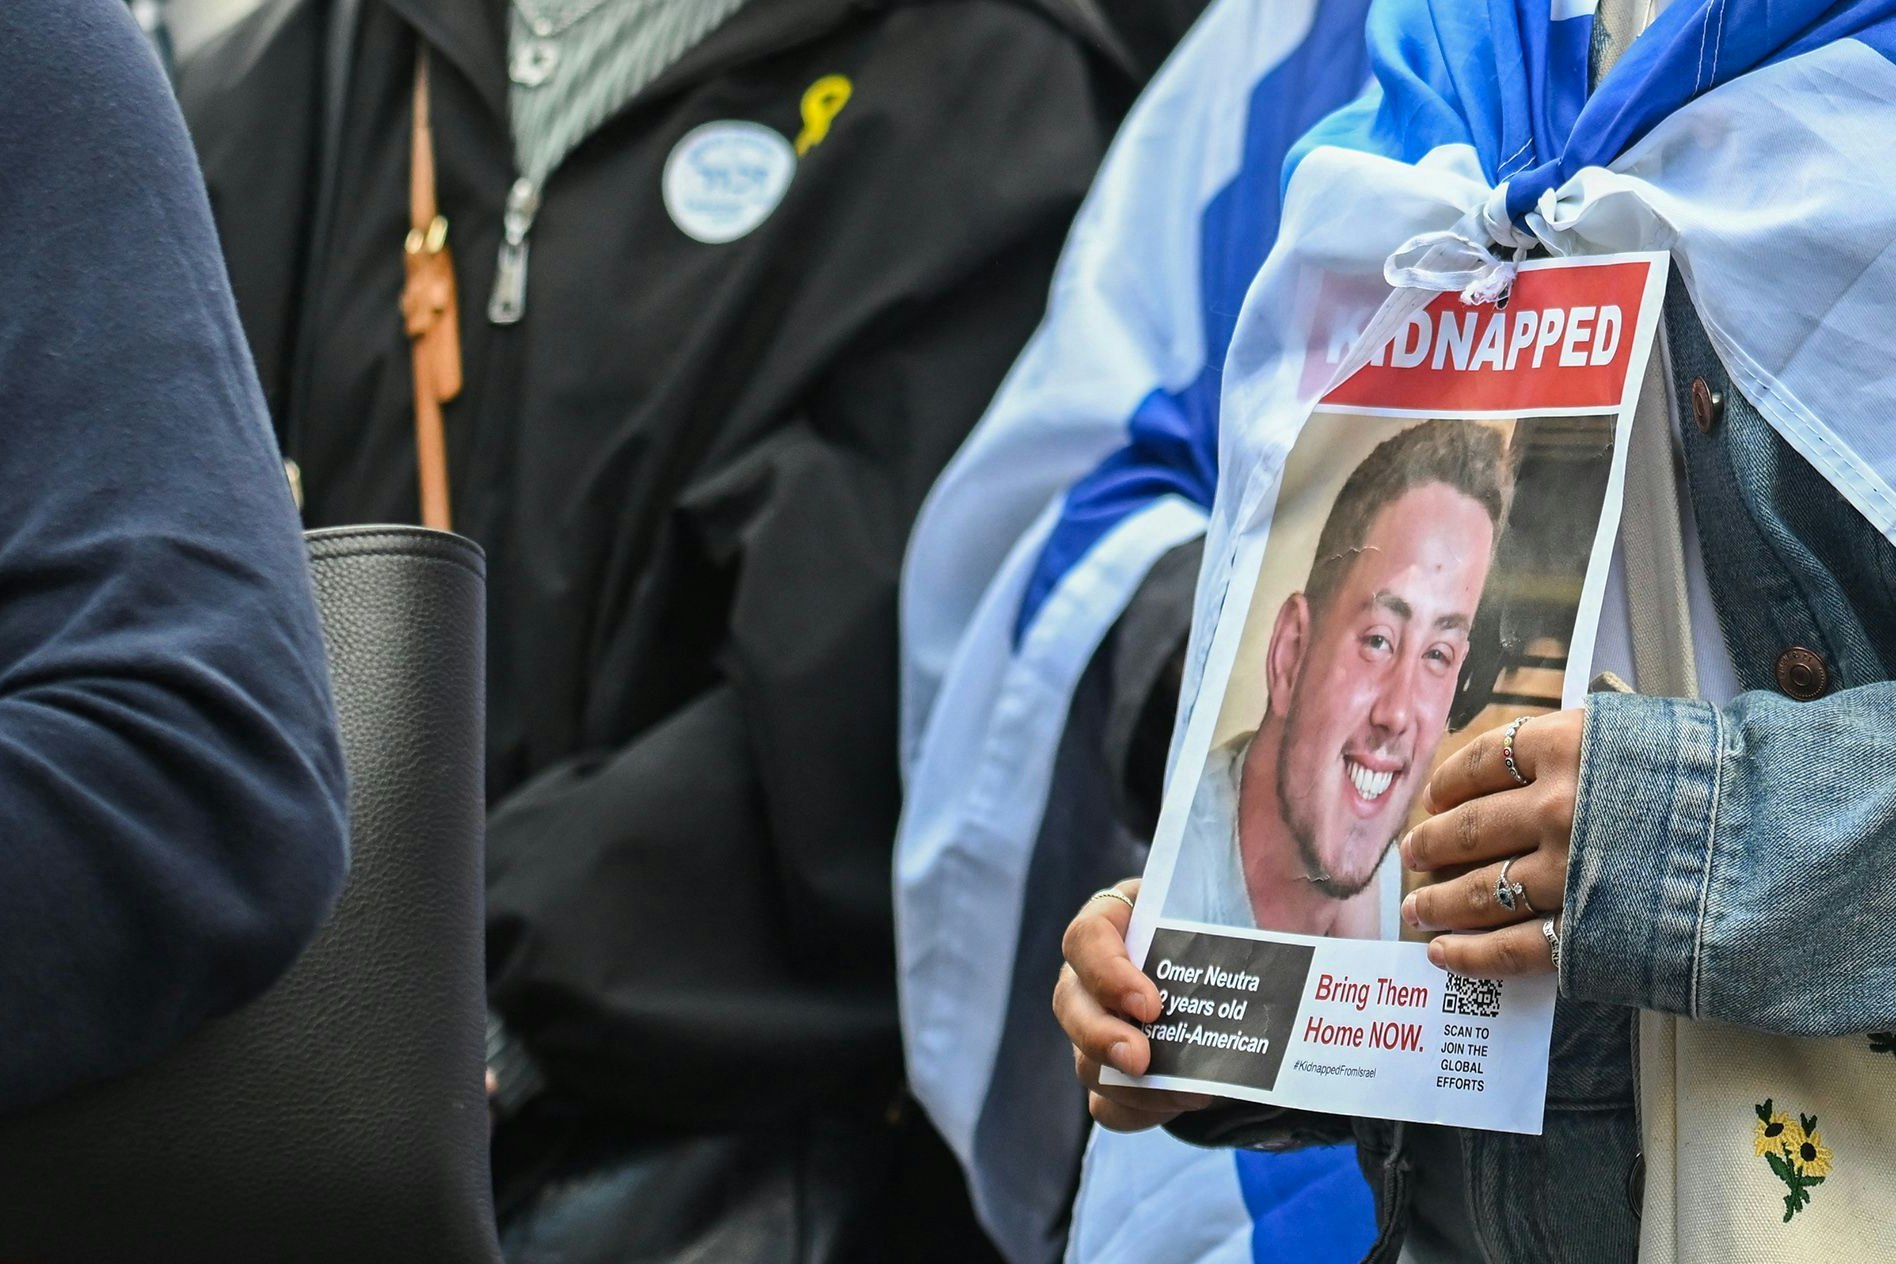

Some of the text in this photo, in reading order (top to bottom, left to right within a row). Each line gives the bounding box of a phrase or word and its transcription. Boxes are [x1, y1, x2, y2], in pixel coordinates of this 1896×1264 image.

[1326, 305, 1622, 371] KDNAPPED
[1156, 958, 1260, 992] Omer Neutra
[1315, 974, 1428, 1011] Bring Them
[1166, 995, 1215, 1016] years
[1217, 999, 1248, 1021] old
[1303, 1016, 1424, 1053] Home NOW.
[1444, 1024, 1490, 1040] SCAN TO
[1441, 1042, 1489, 1057] JOIN THE
[1293, 1060, 1377, 1078] #KidnappedFromIsrael
[1441, 1059, 1484, 1074] GLOBAL
[1436, 1076, 1485, 1092] EFFORTS
